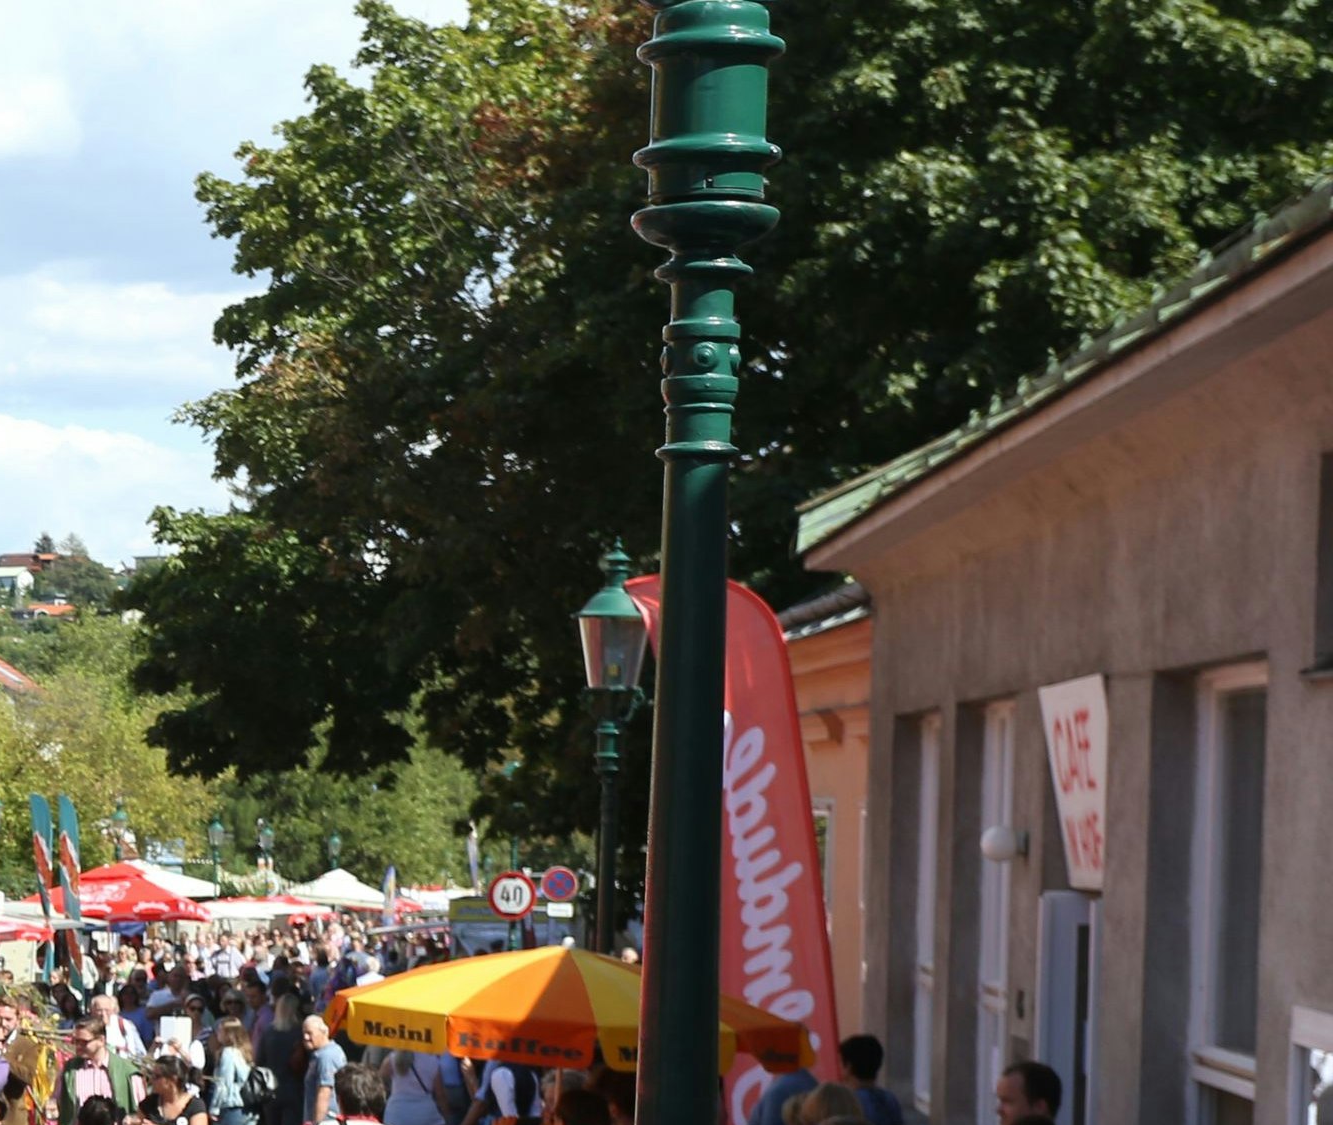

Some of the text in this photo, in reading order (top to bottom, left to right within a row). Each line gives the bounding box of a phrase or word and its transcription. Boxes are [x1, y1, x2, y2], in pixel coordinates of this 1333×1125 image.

[500, 885, 523, 905] 40
[363, 1020, 433, 1044] Meinl
[457, 1032, 583, 1060] Kaffee
[618, 1046, 637, 1062] M
